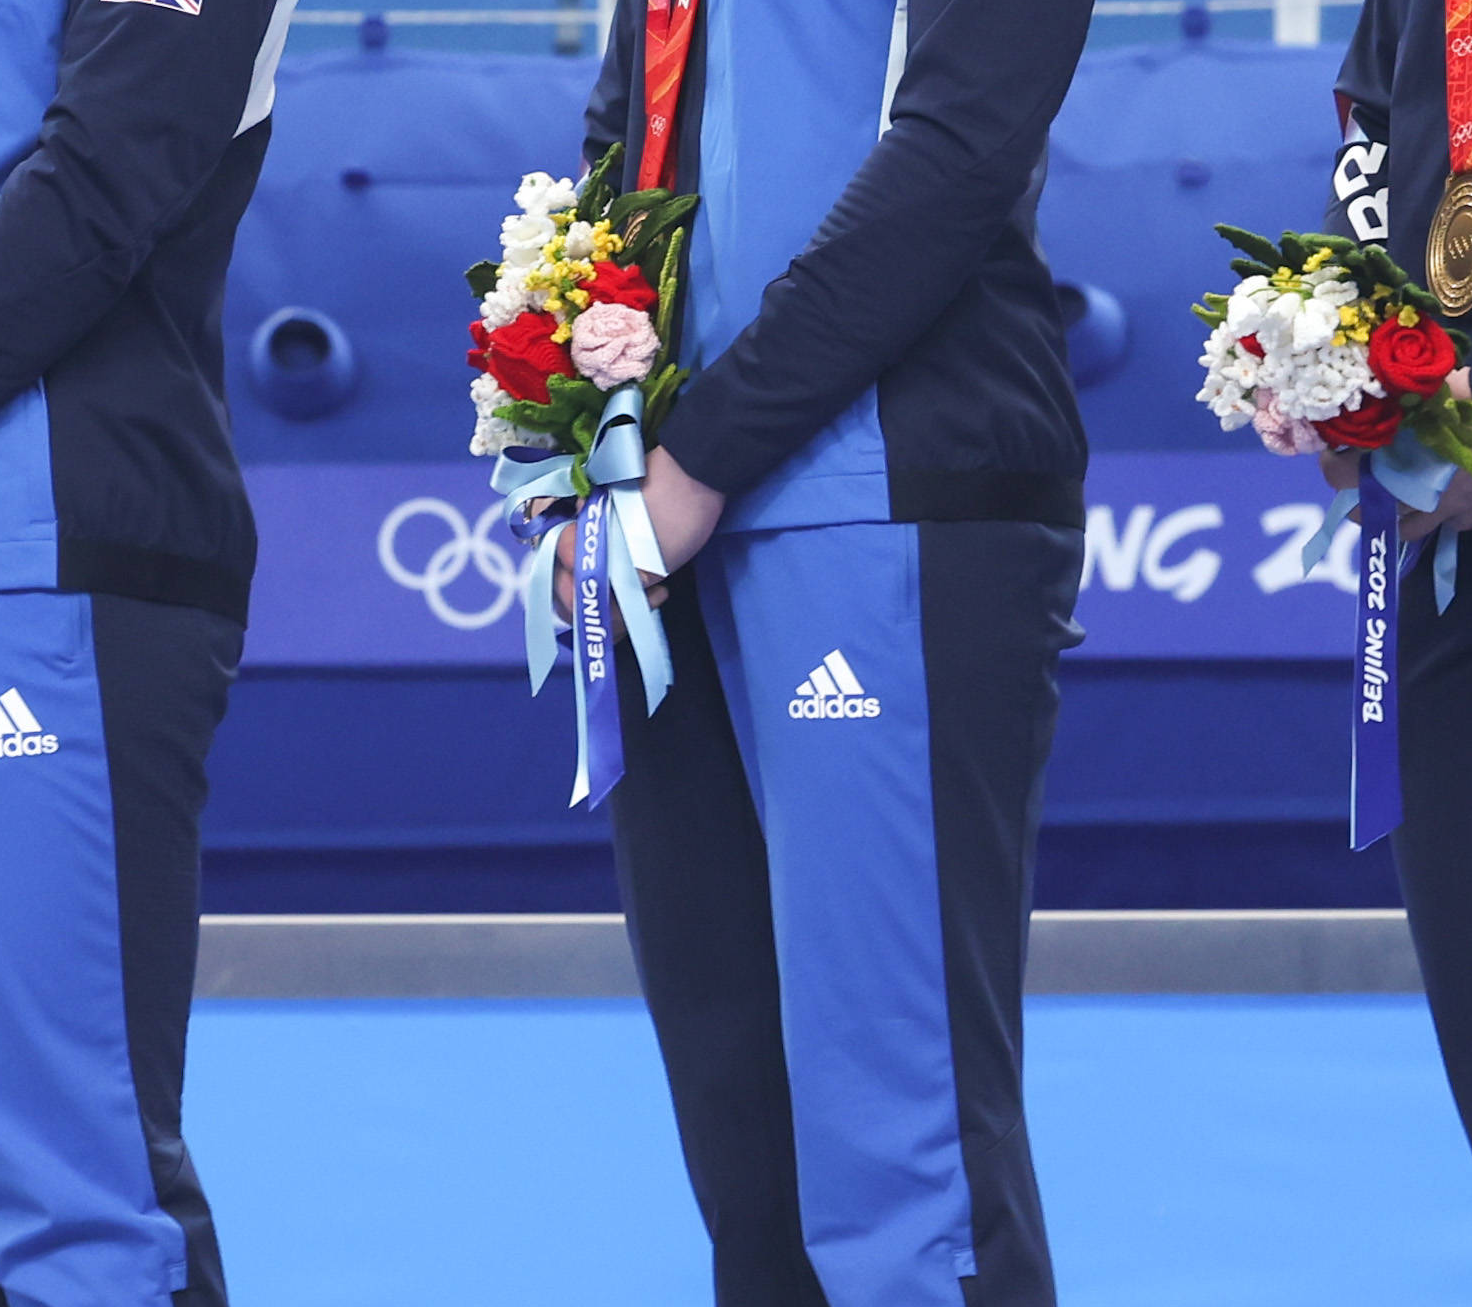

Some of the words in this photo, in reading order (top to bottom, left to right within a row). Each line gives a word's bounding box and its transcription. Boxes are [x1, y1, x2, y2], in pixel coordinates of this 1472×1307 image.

[582, 495, 604, 571] 2022
[1367, 529, 1387, 611] 2022
[581, 578, 607, 683] BEIJING
[1362, 618, 1389, 723] BEIJING
[788, 693, 881, 721] adidas
